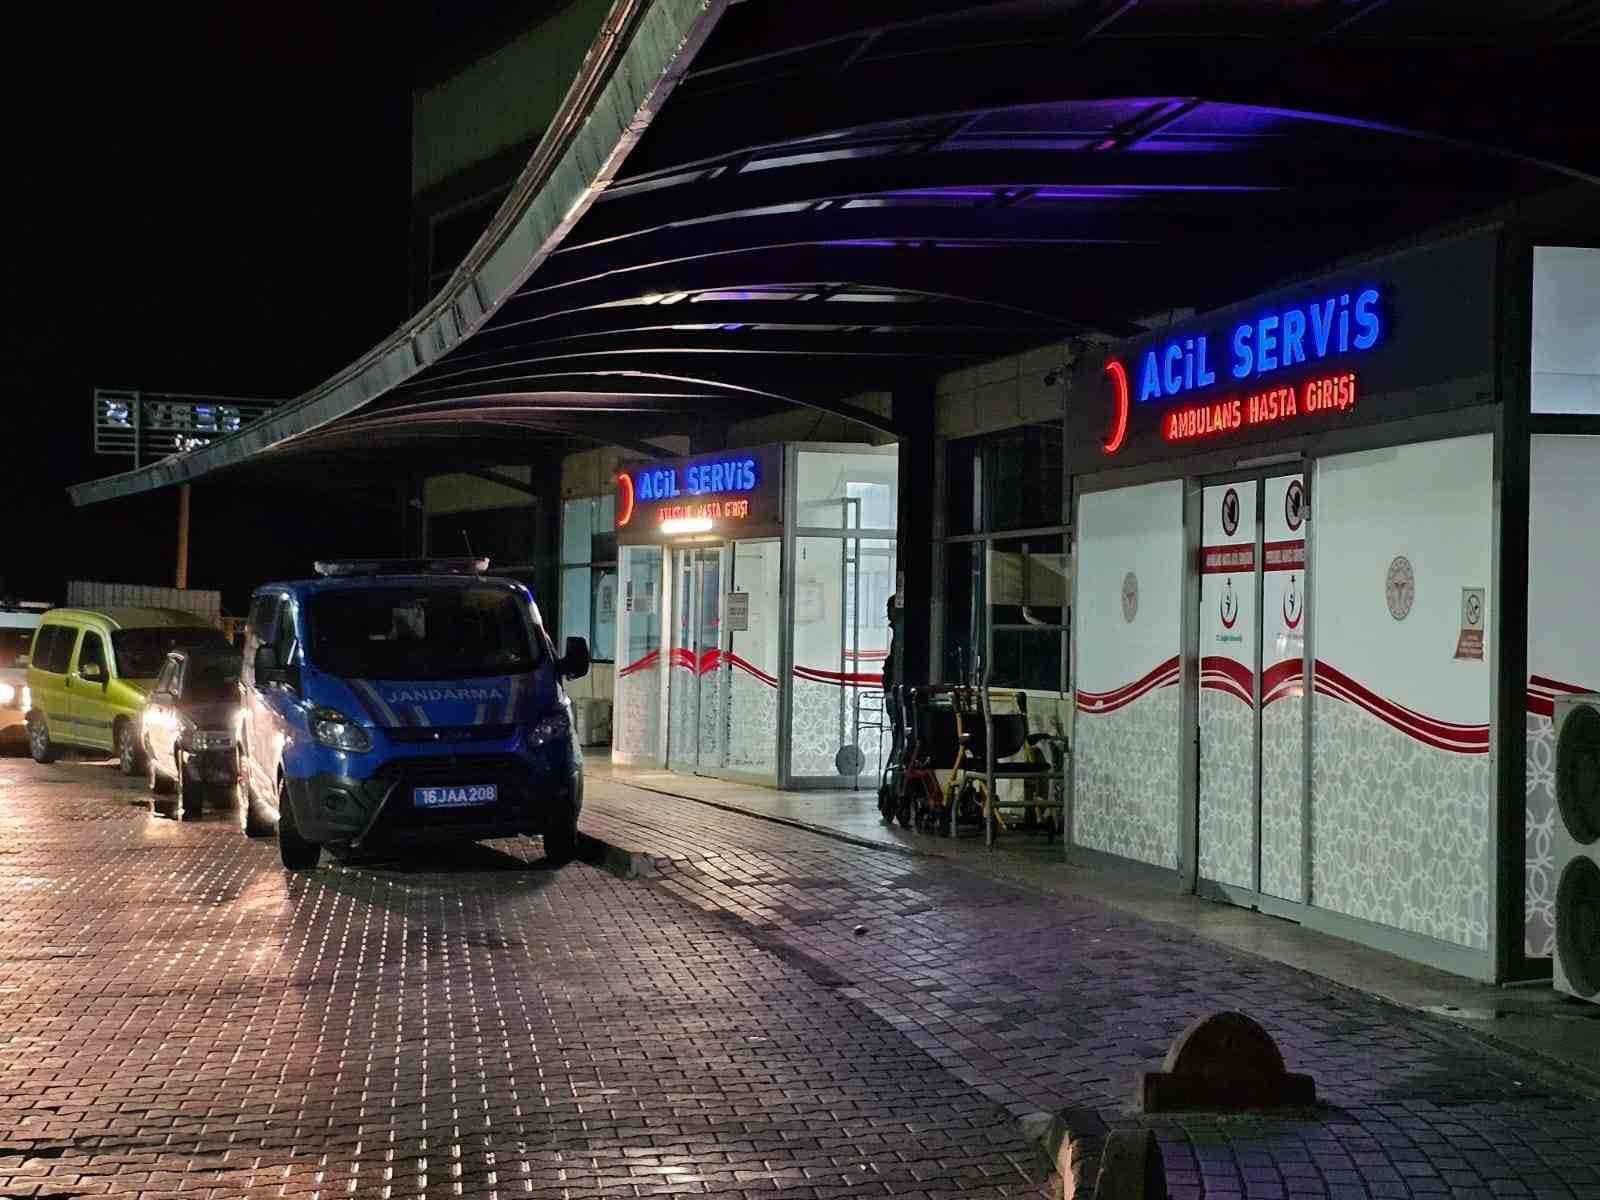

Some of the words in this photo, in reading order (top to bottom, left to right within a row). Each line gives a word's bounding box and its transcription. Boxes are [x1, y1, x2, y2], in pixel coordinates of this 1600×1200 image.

[1168, 400, 1241, 440] AMBULANS
[1249, 387, 1297, 424] HASTA
[387, 687, 504, 703] JANDARMA
